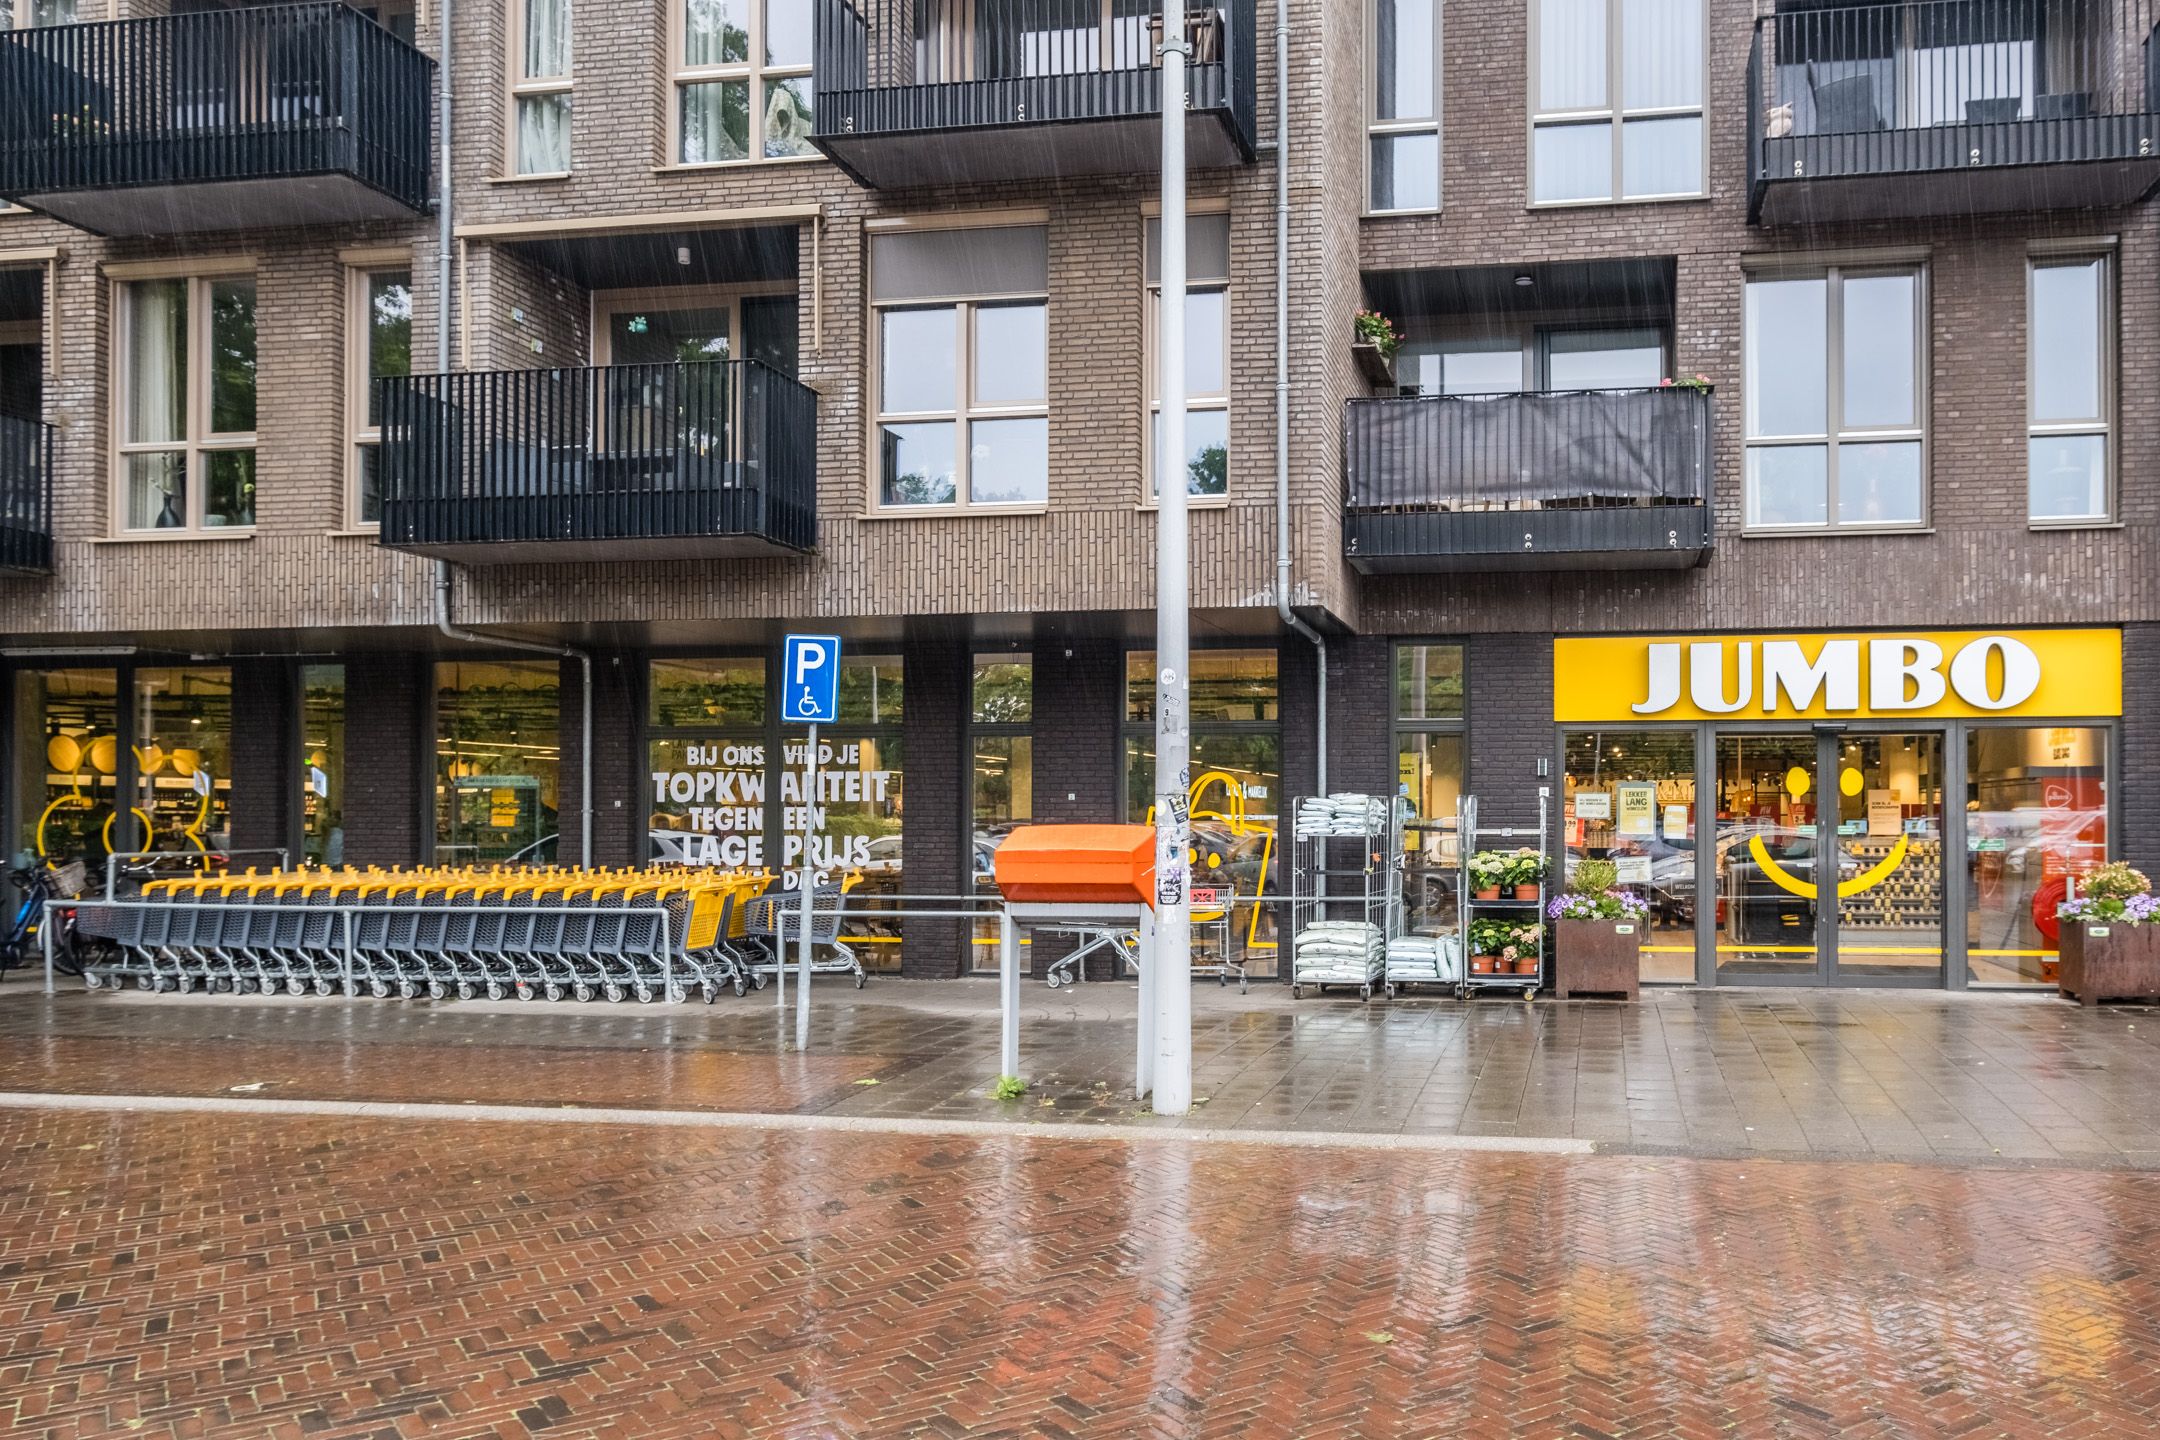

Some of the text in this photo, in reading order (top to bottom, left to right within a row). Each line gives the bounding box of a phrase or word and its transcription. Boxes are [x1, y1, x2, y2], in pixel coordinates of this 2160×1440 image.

[796, 642, 826, 685] P
[1631, 635, 2041, 714] JUMBO
[686, 745, 717, 766] BIJ
[723, 745, 765, 766] ONS
[836, 744, 859, 765] JE
[1625, 797, 1648, 806] LANG
[688, 806, 826, 831] TEGEN EEN
[682, 835, 871, 868] LAGE PRIJS
[783, 870, 829, 891] DG
